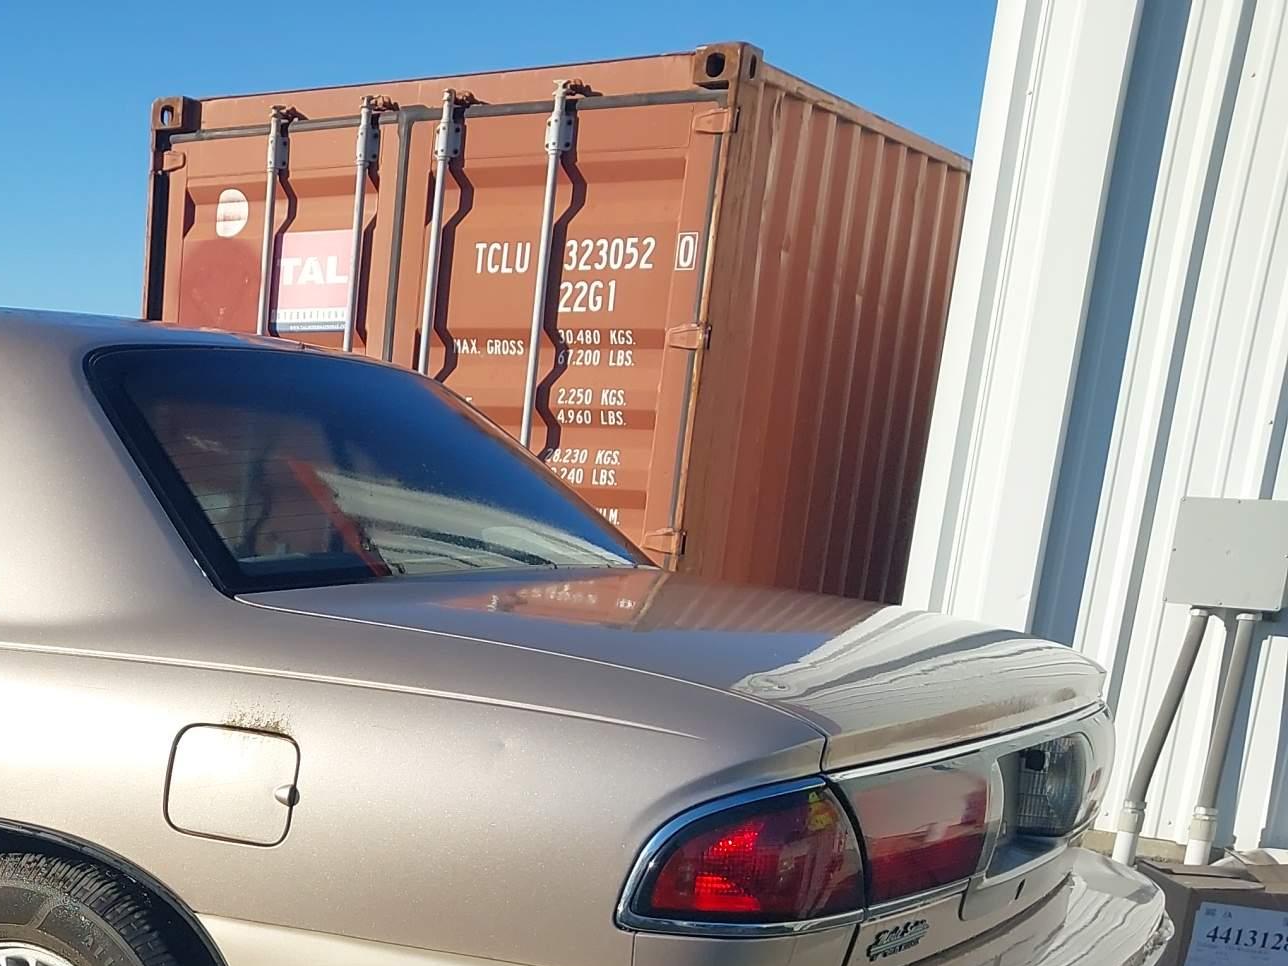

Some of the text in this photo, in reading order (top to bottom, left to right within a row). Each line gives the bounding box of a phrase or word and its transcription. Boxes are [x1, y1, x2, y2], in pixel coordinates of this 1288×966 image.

[476, 241, 531, 274] TCLU
[563, 234, 696, 270] 323052 0
[276, 255, 350, 286] TAL
[558, 280, 617, 313] 22G1
[453, 338, 524, 356] MAX. GROSS
[558, 329, 637, 346] 30.480 KGS.
[557, 349, 635, 367] 67.200 LBS.
[557, 388, 627, 407] 2.250 KGS.
[557, 409, 627, 426] 4.960 LBS.
[543, 447, 621, 466] 28.230 KGS.
[591, 467, 618, 487] LBS.
